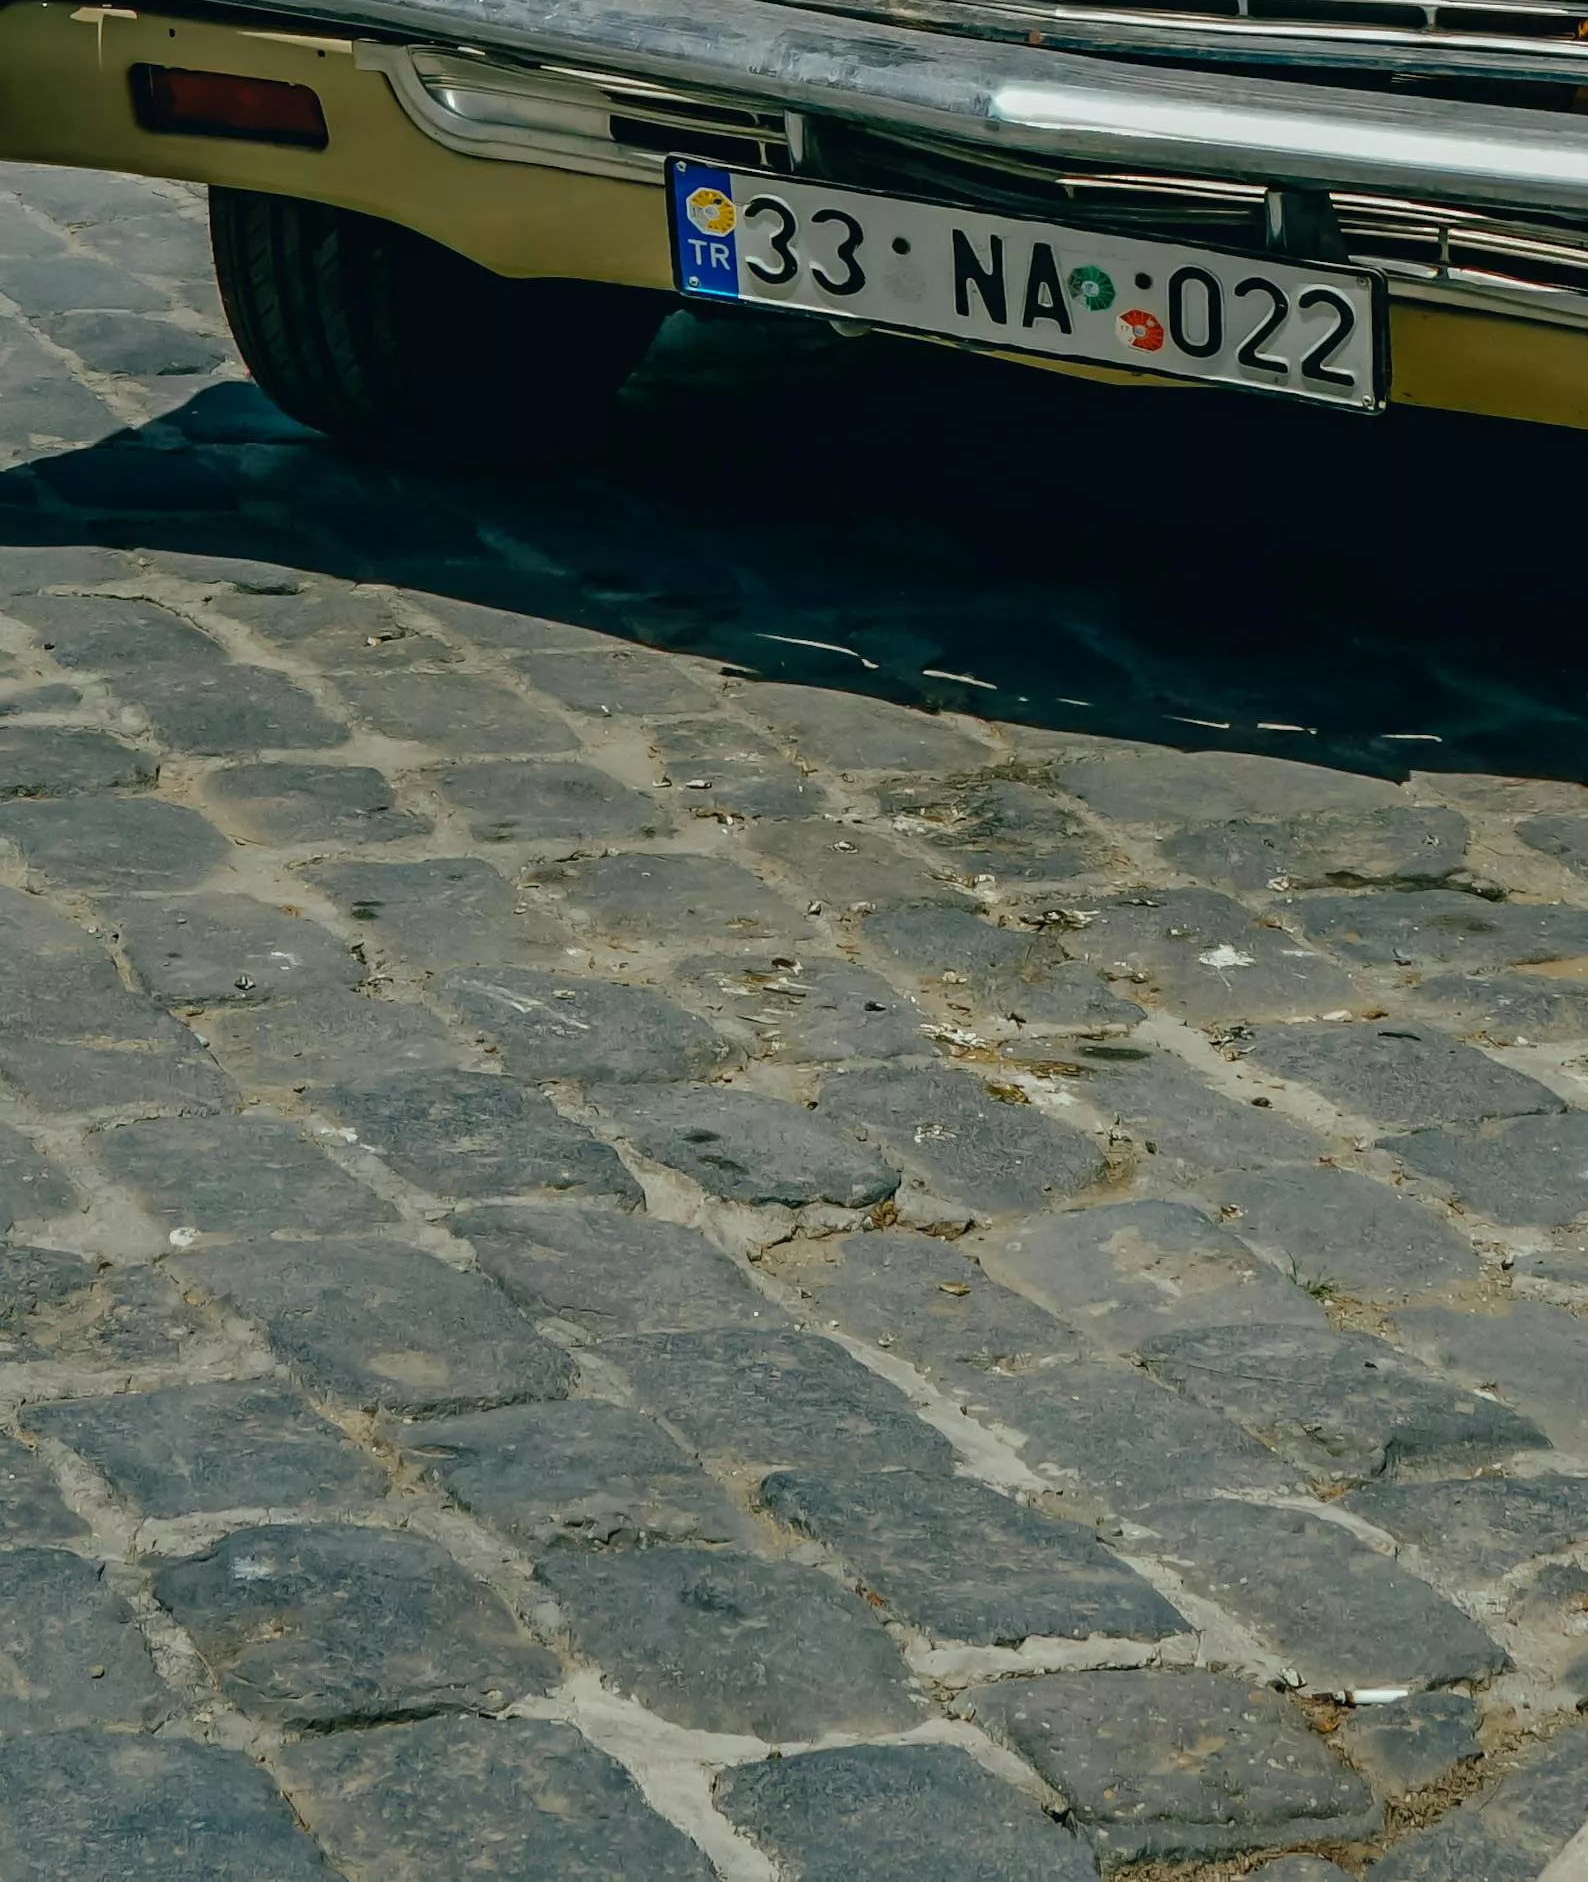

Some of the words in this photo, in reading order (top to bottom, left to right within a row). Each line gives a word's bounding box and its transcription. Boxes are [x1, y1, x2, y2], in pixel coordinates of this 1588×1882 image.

[687, 238, 731, 271] TR
[744, 196, 867, 297] 33
[952, 228, 1073, 335] NA
[1168, 265, 1355, 387] 022
